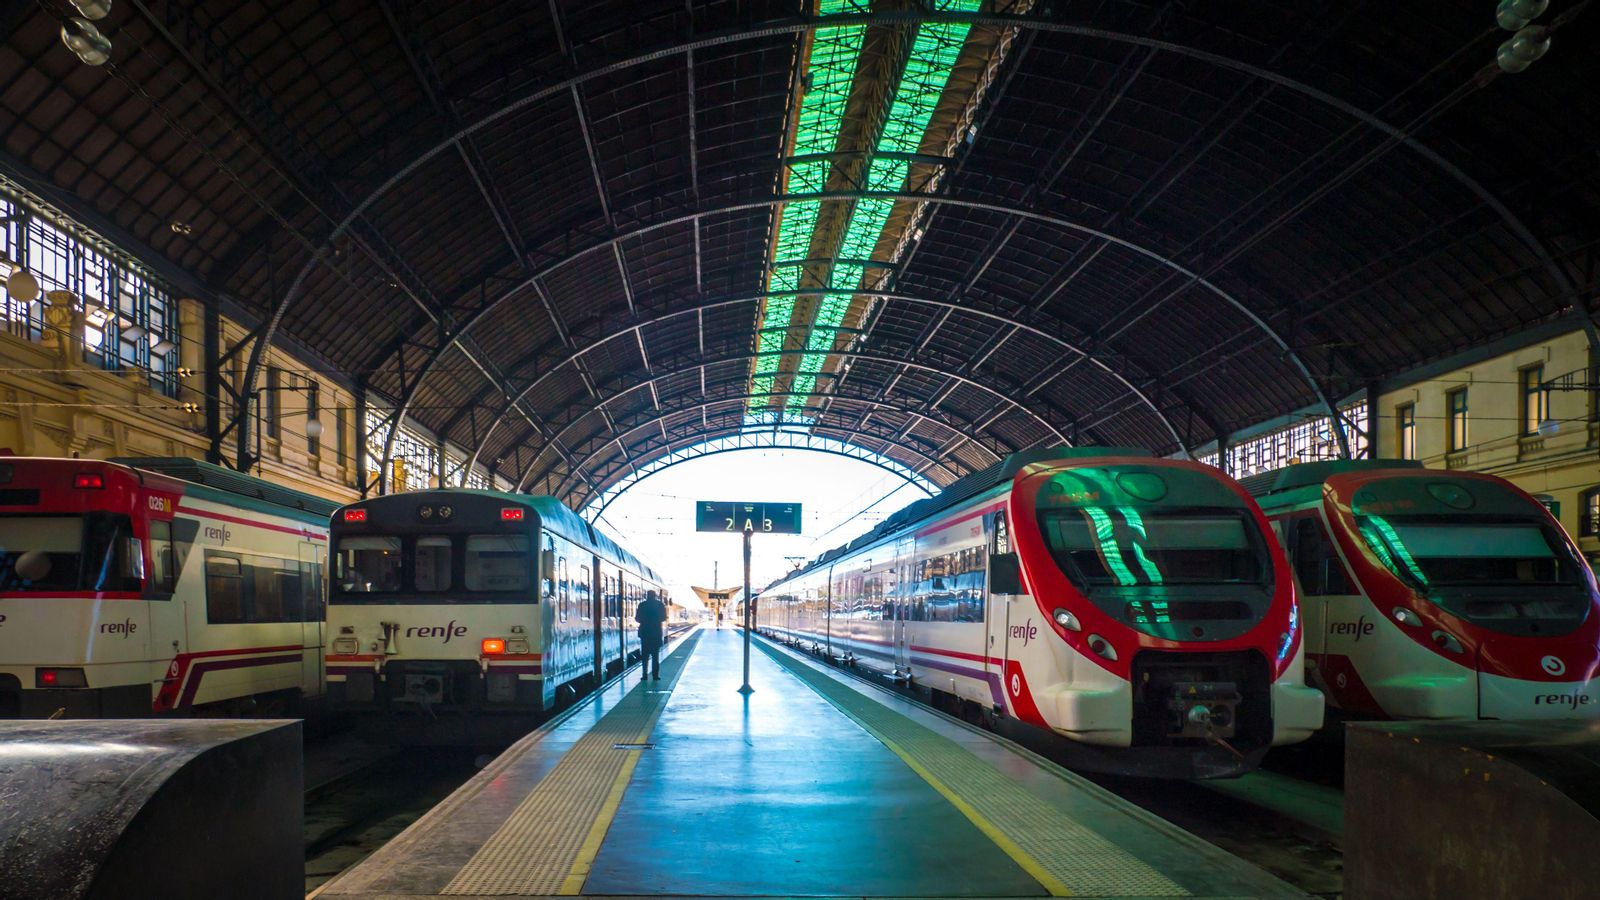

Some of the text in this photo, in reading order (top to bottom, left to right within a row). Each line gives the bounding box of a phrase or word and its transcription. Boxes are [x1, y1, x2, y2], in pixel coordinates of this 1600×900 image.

[204, 524, 231, 547] renfe
[725, 518, 773, 532] 2 A 3
[100, 617, 137, 639] renfe
[406, 619, 468, 644] renfe
[1009, 617, 1037, 647] renfe
[1330, 615, 1375, 642] renfe
[1534, 688, 1590, 710] renfe
